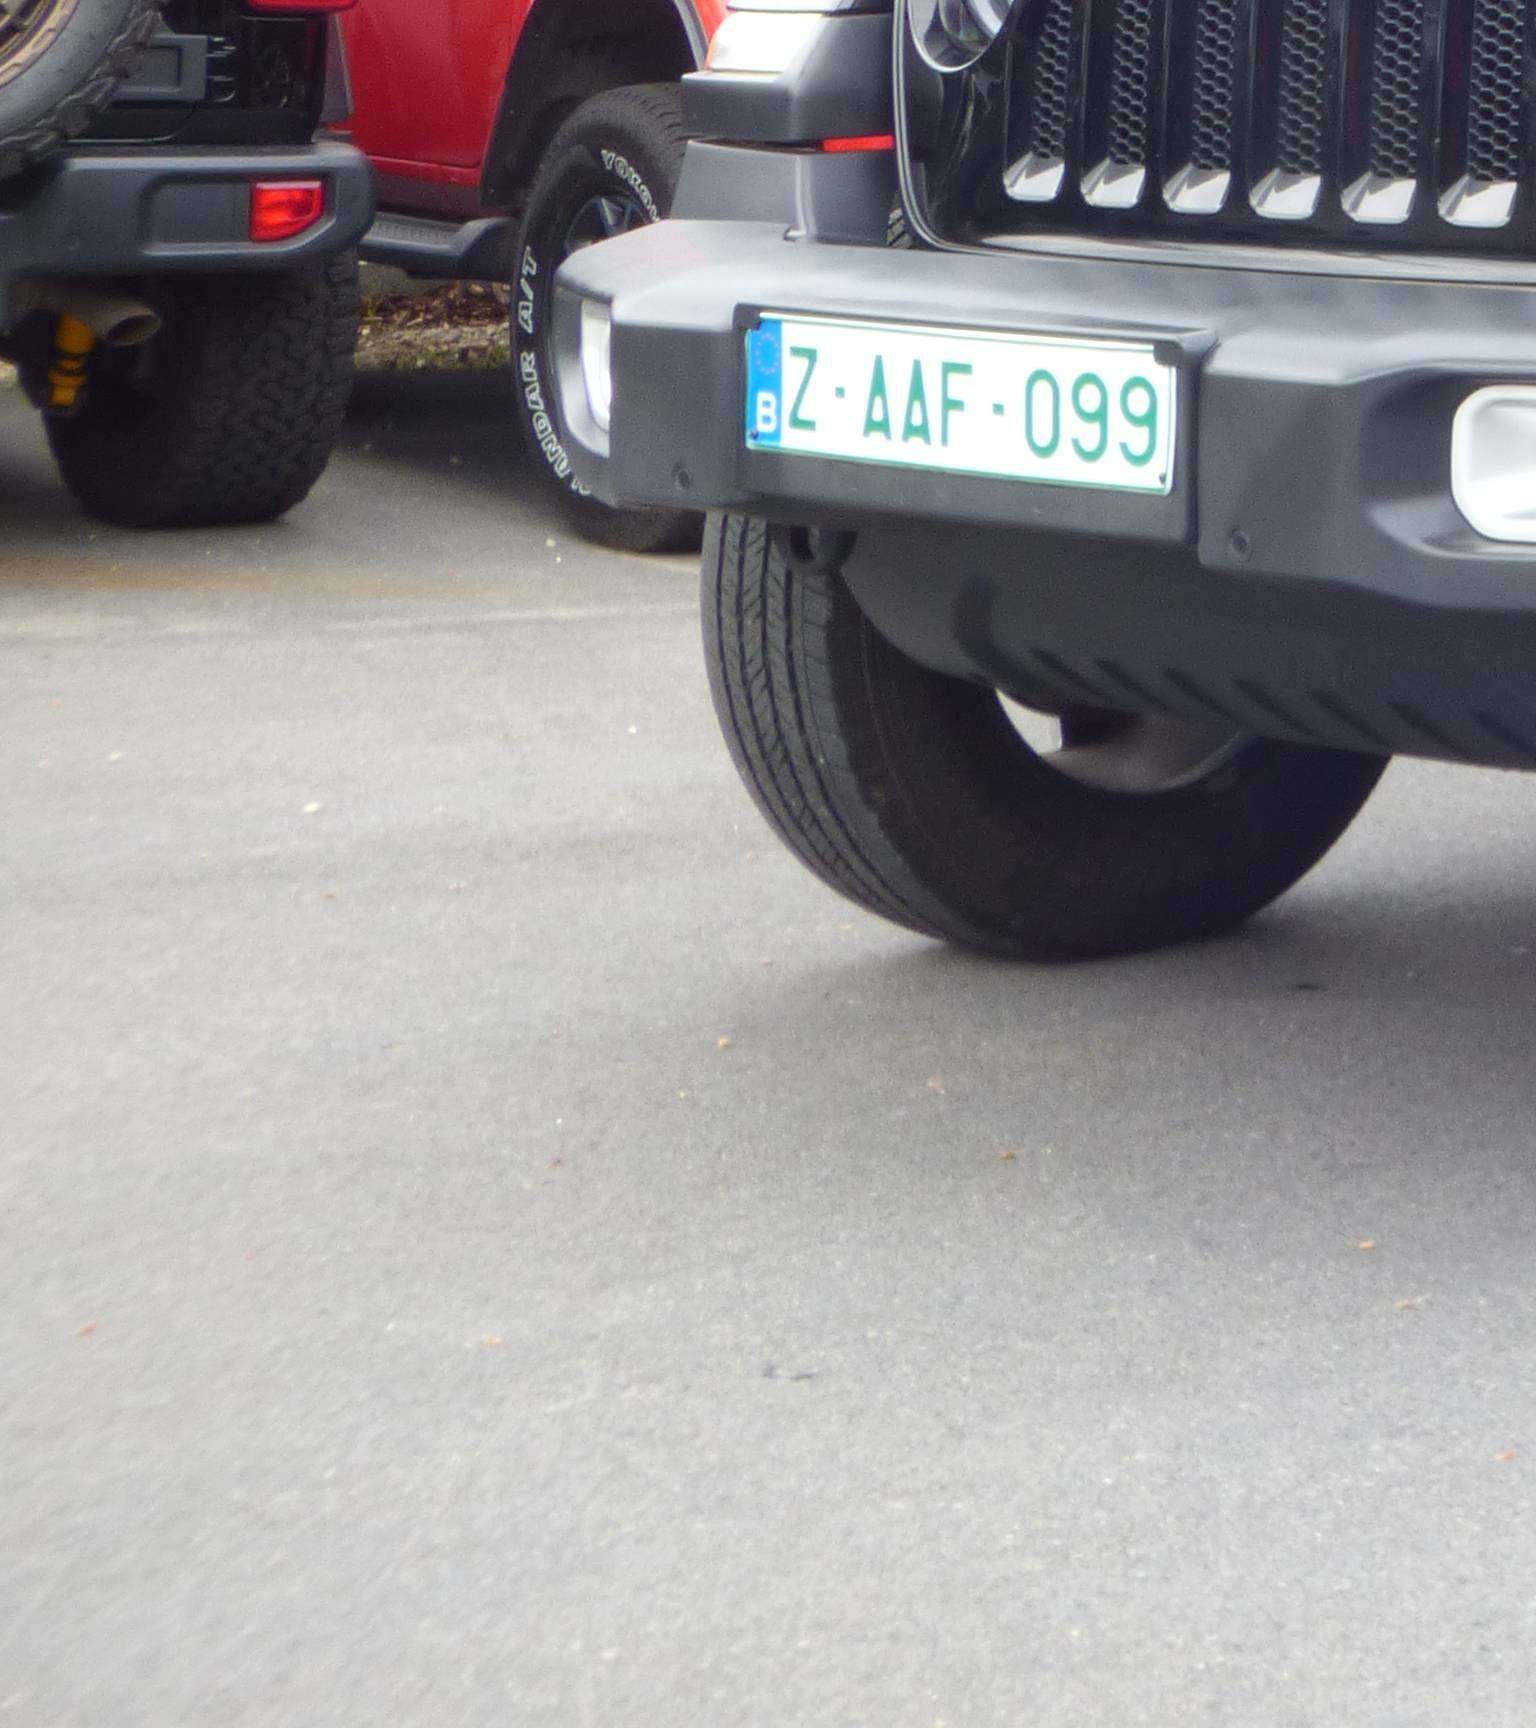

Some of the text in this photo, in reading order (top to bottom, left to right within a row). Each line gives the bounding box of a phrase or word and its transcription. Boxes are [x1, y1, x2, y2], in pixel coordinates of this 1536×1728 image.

[600, 148, 660, 222] YOKOH
[518, 246, 537, 334] A/T
[756, 392, 777, 433] B
